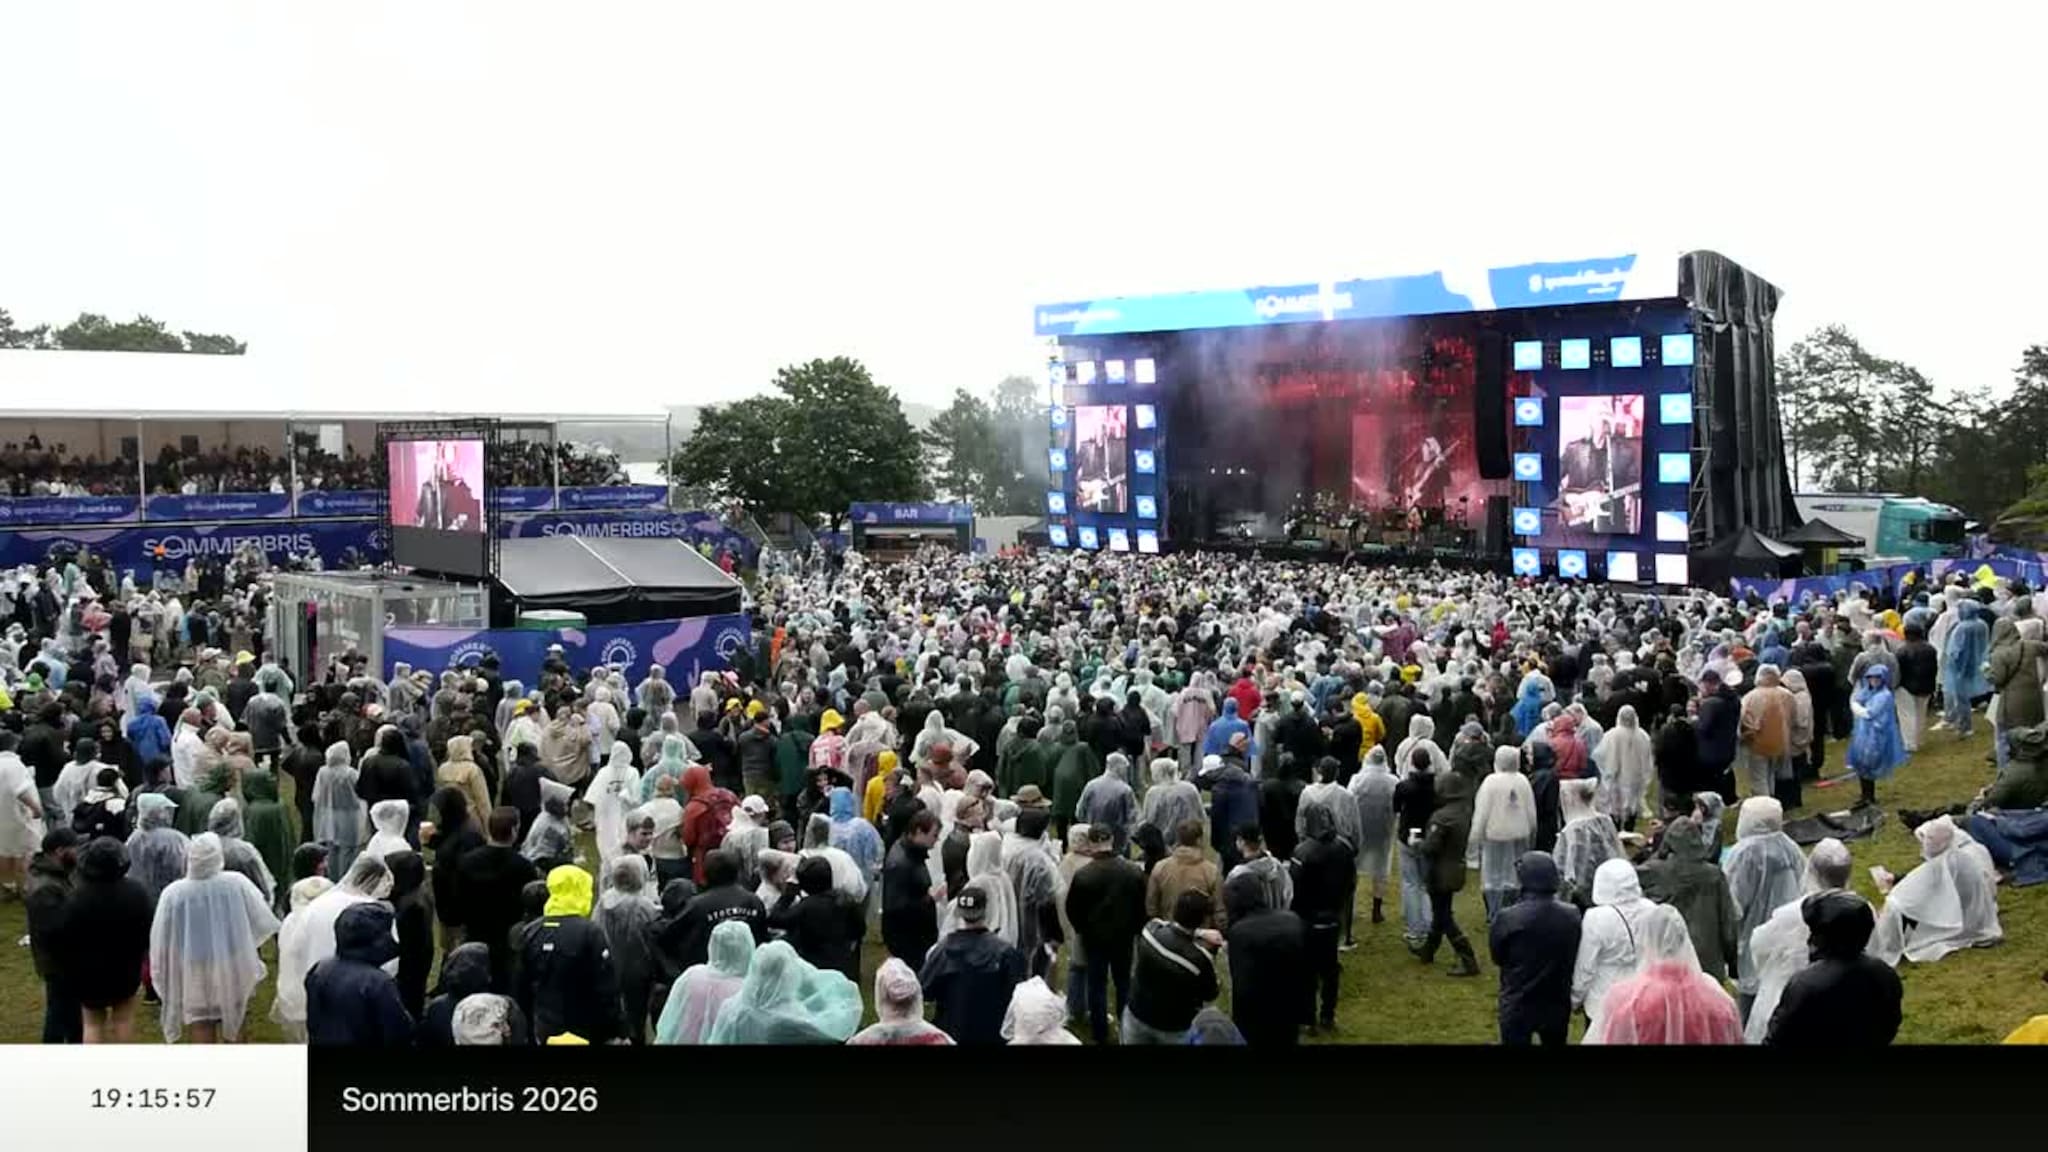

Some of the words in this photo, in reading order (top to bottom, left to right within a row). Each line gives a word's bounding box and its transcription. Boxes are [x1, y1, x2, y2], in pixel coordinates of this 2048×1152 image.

[894, 508, 918, 519] BAR
[541, 520, 672, 538] SOMMERBRIS
[383, 612, 395, 629] 2
